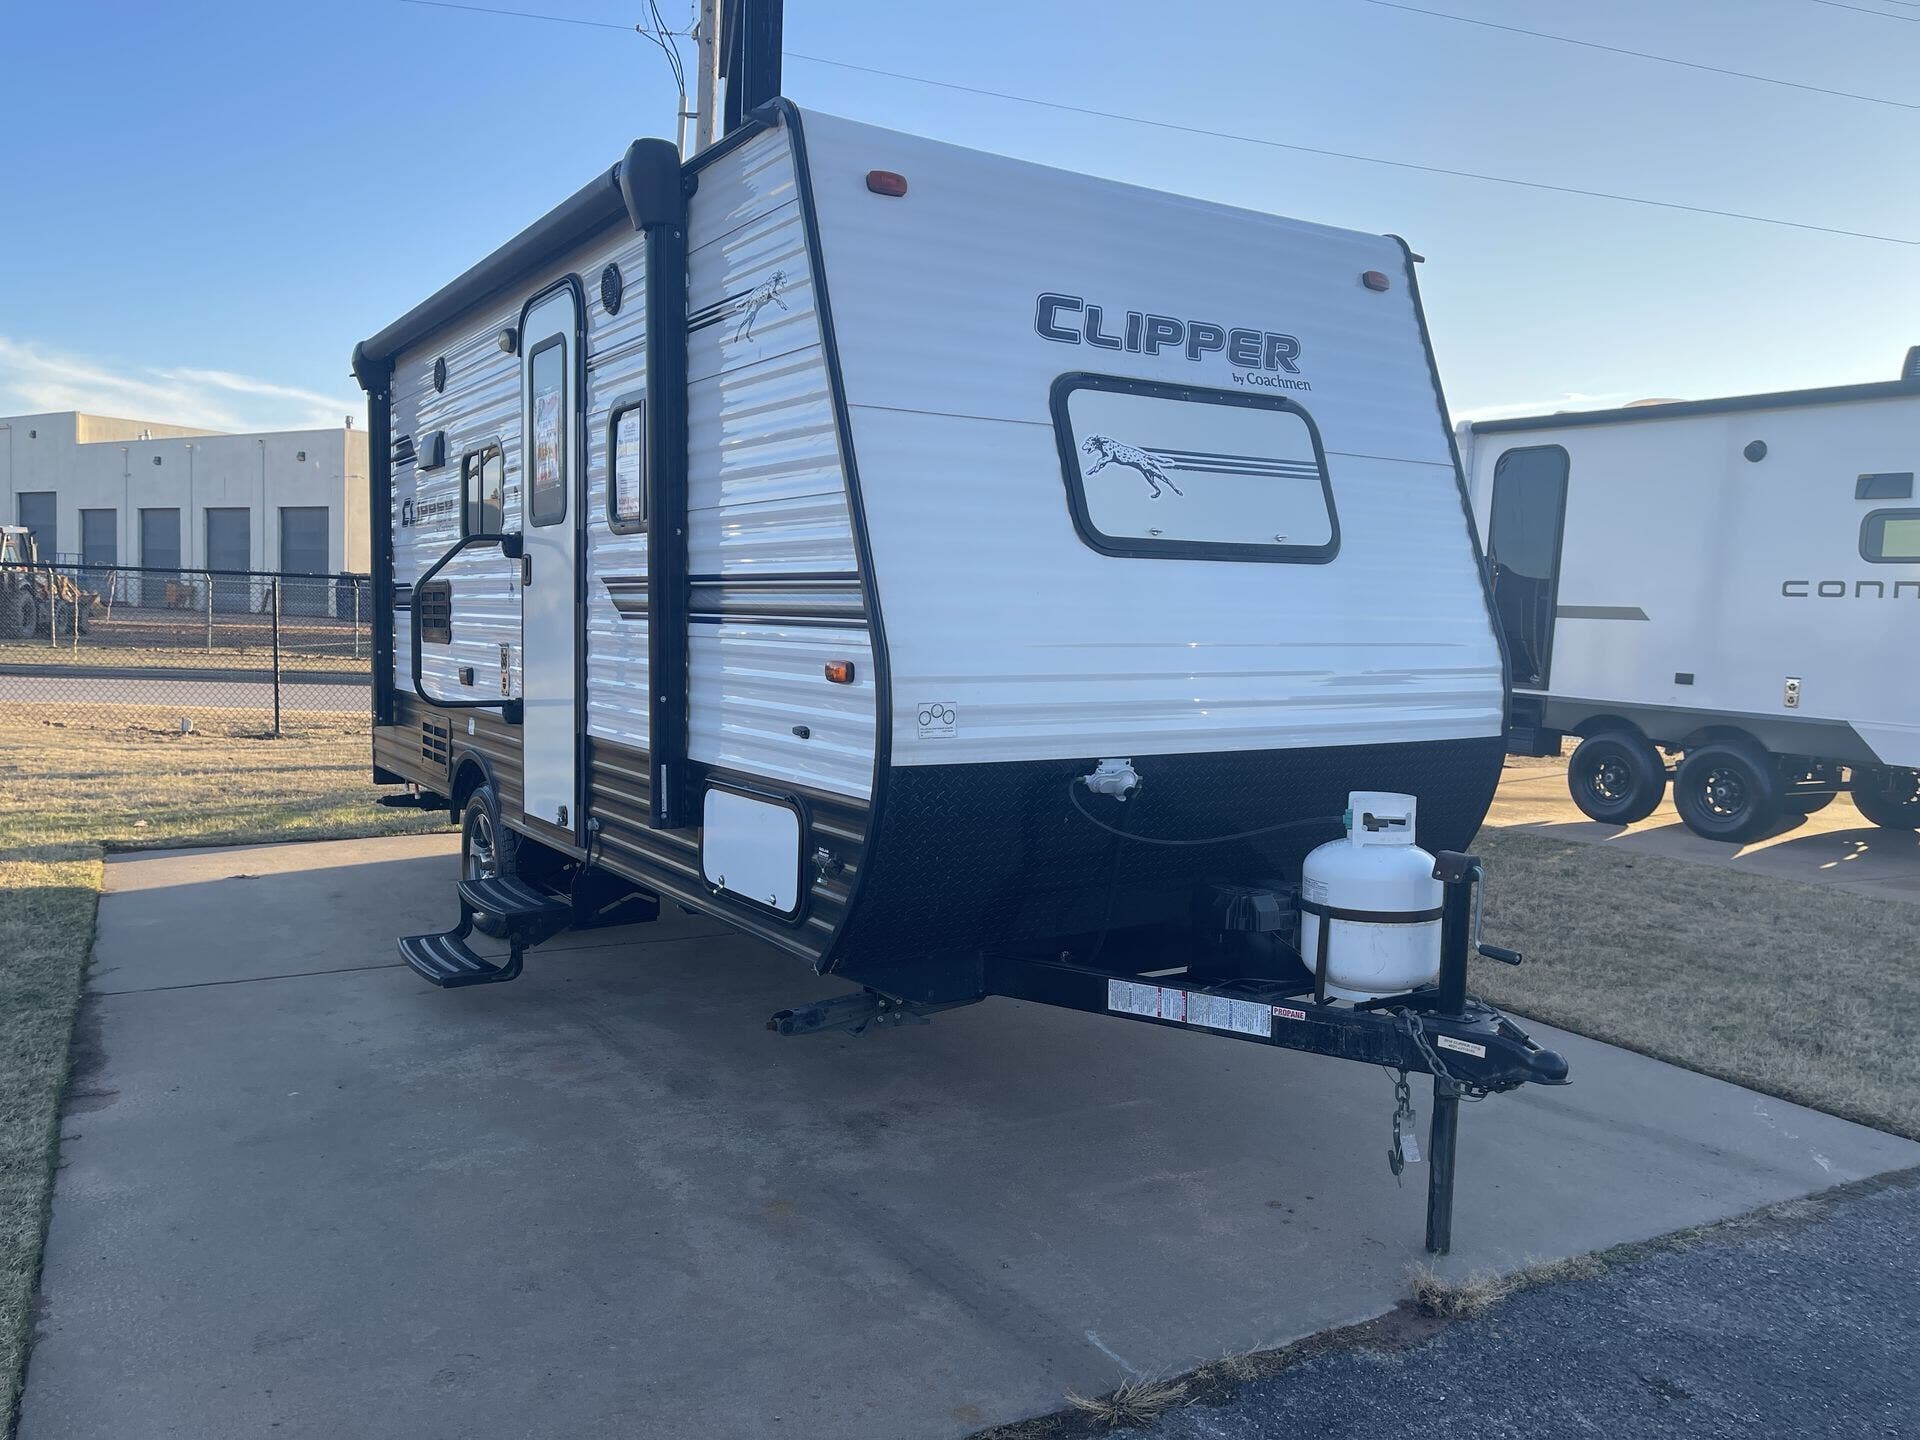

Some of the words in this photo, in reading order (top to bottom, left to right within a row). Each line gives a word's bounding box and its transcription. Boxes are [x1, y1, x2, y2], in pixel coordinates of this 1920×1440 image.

[1034, 292, 1301, 374] CLIPPER
[1232, 372, 1245, 386] by
[1246, 372, 1312, 392] Coachmen
[1273, 1007, 1305, 1020] PROPANE
